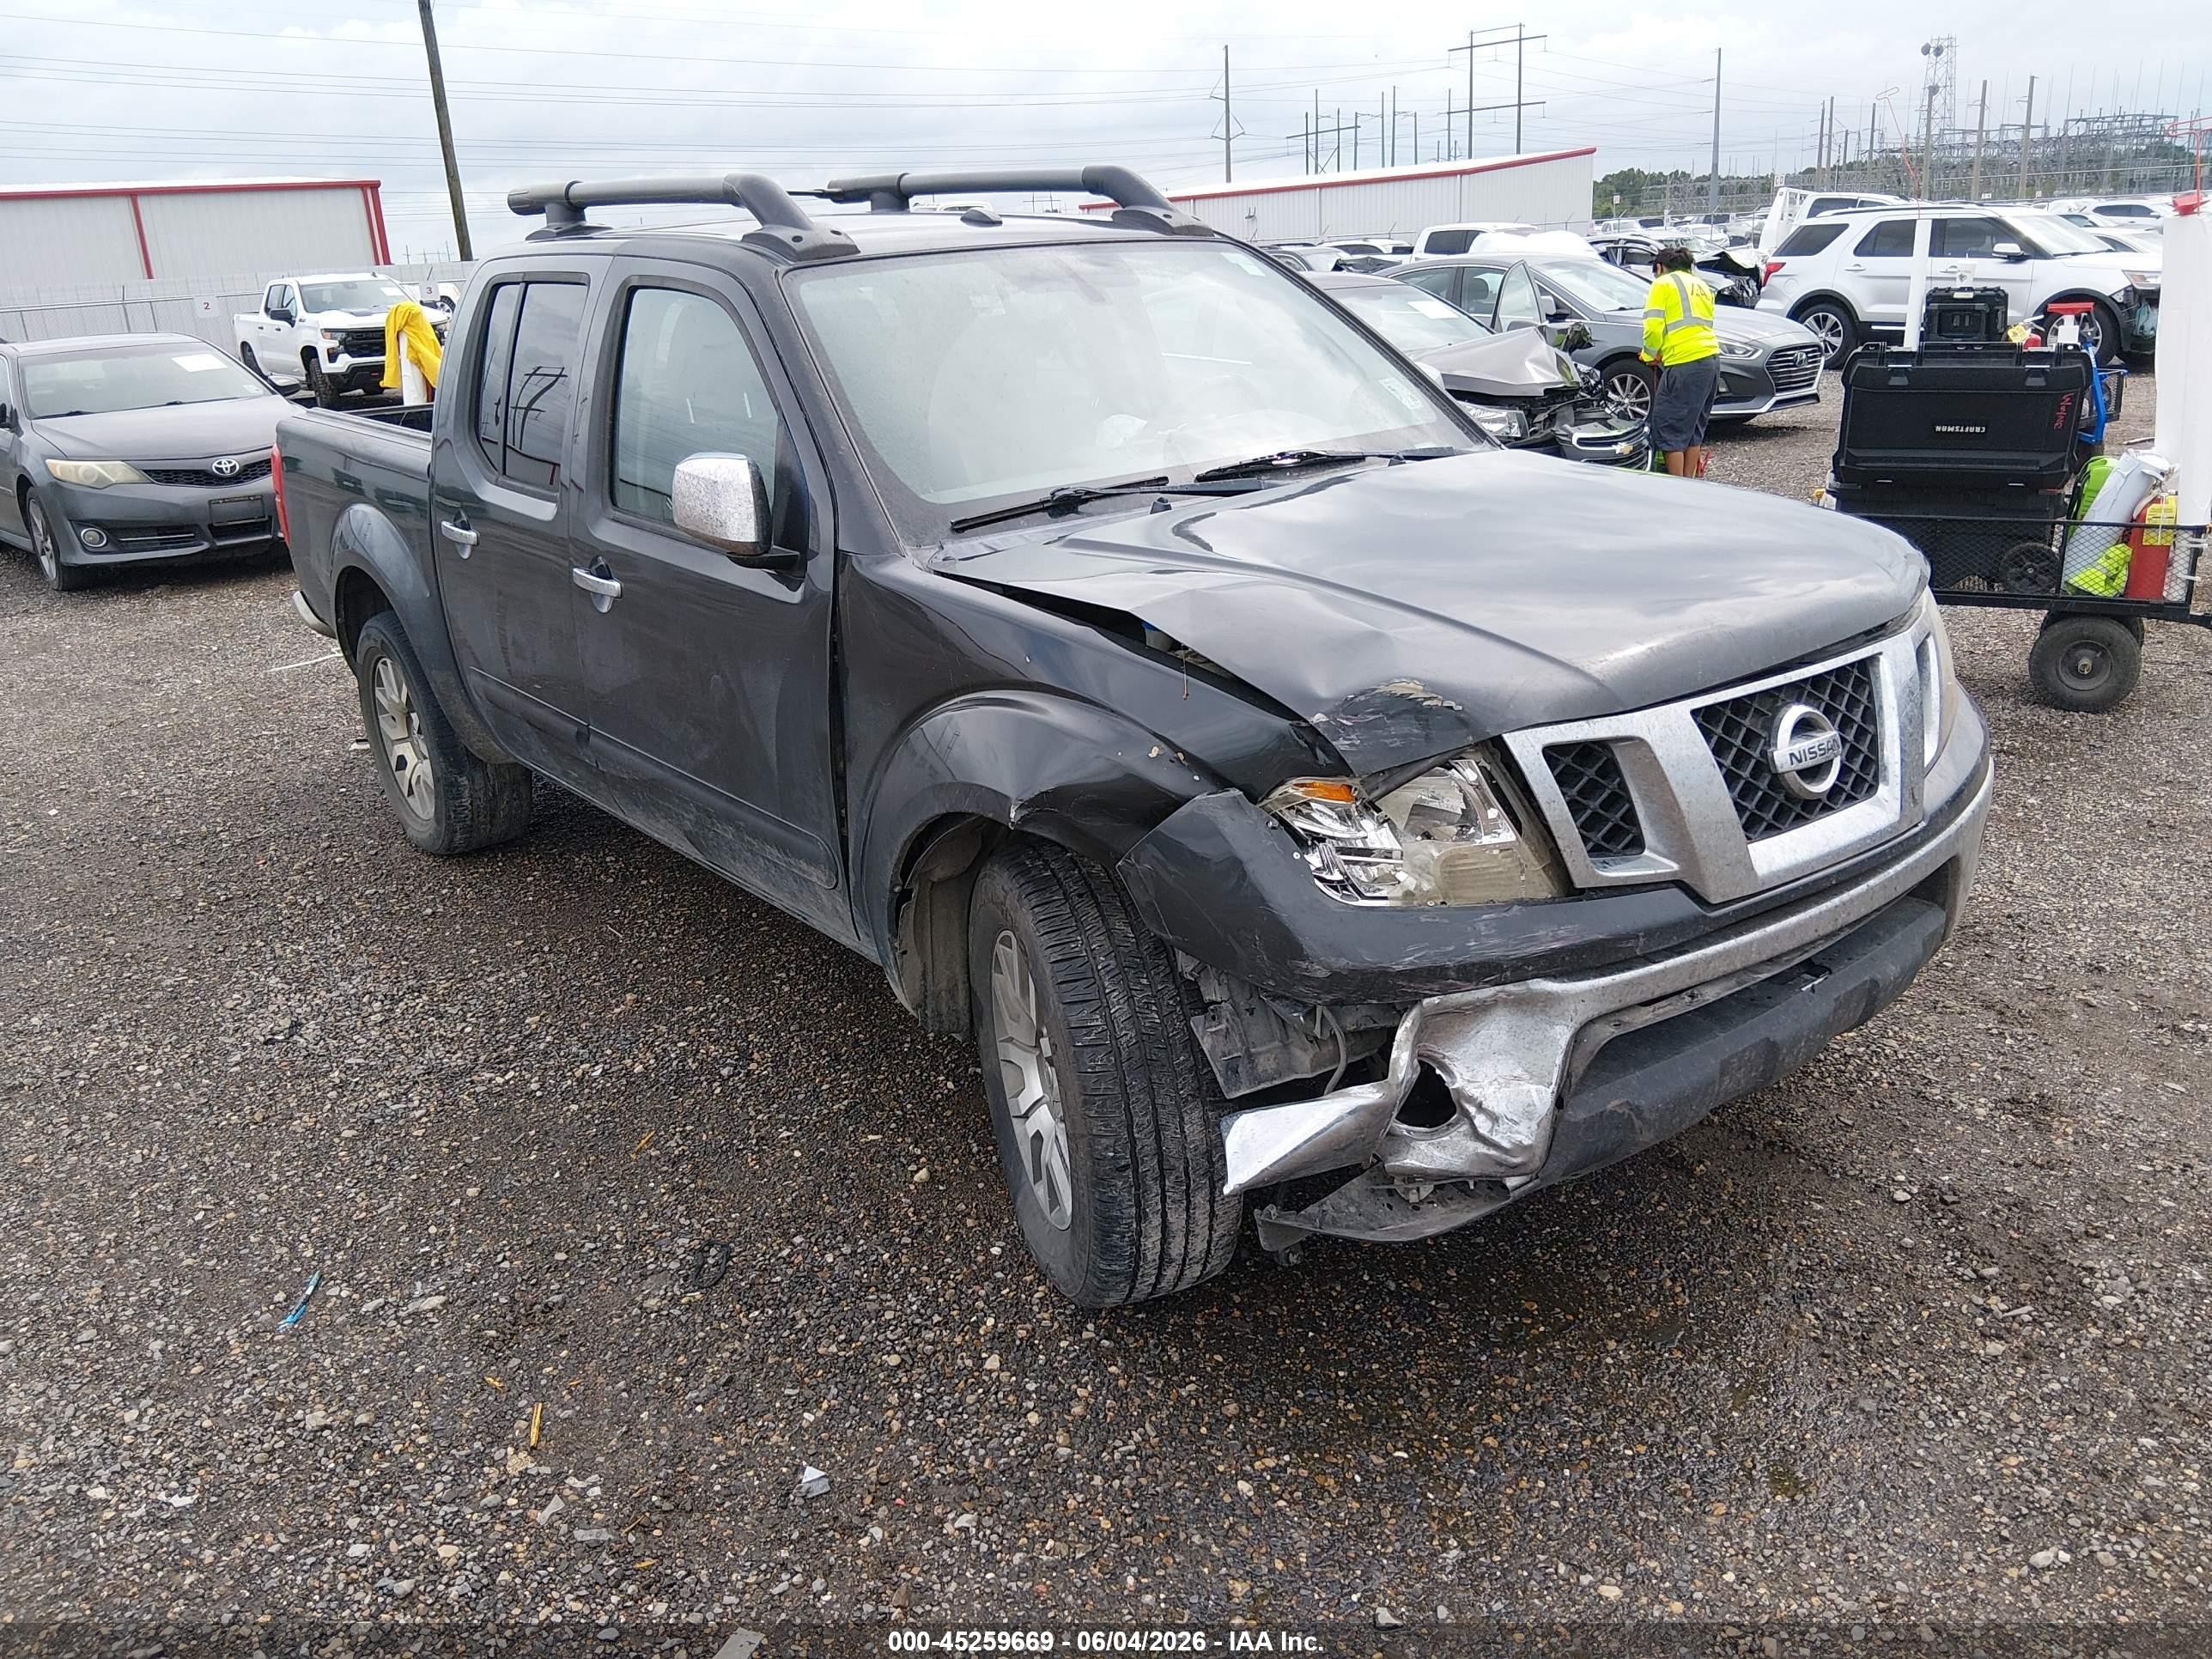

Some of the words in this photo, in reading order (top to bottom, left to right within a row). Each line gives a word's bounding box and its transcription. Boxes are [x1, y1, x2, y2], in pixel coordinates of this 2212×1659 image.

[203, 301, 210, 310] 2
[1934, 425, 1986, 434] CRAFTSMAN
[1789, 738, 1840, 766] NISSAN
